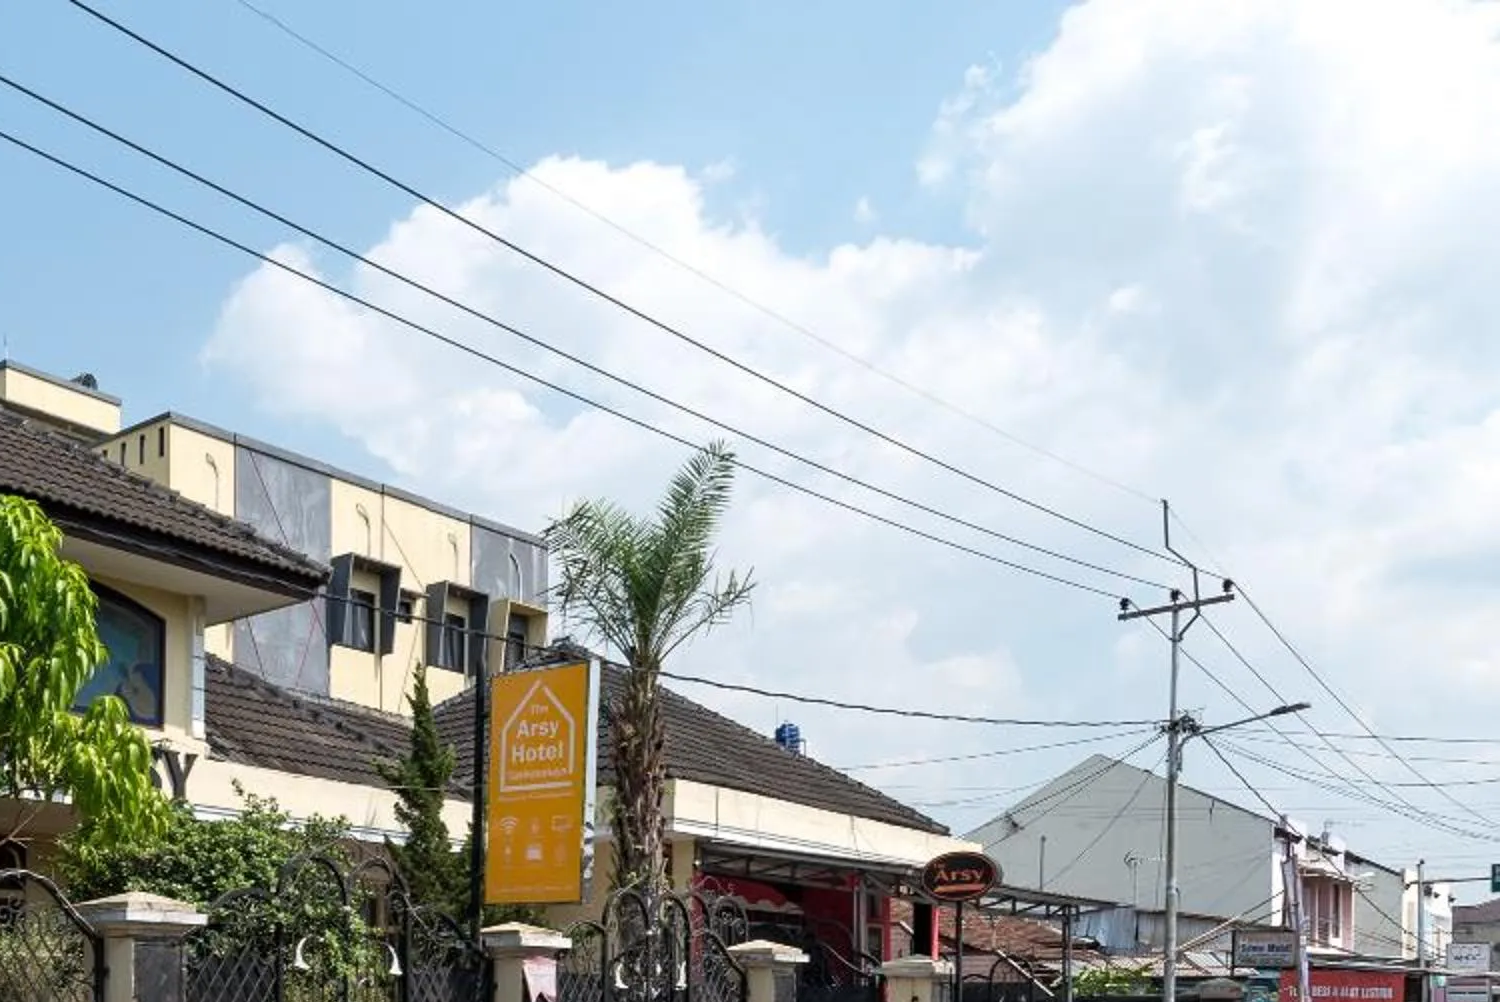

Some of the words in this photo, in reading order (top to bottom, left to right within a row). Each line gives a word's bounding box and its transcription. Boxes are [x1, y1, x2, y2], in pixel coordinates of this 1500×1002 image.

[515, 719, 559, 739] Arsy
[512, 739, 564, 765] Hotel
[934, 868, 984, 883] Arsy
